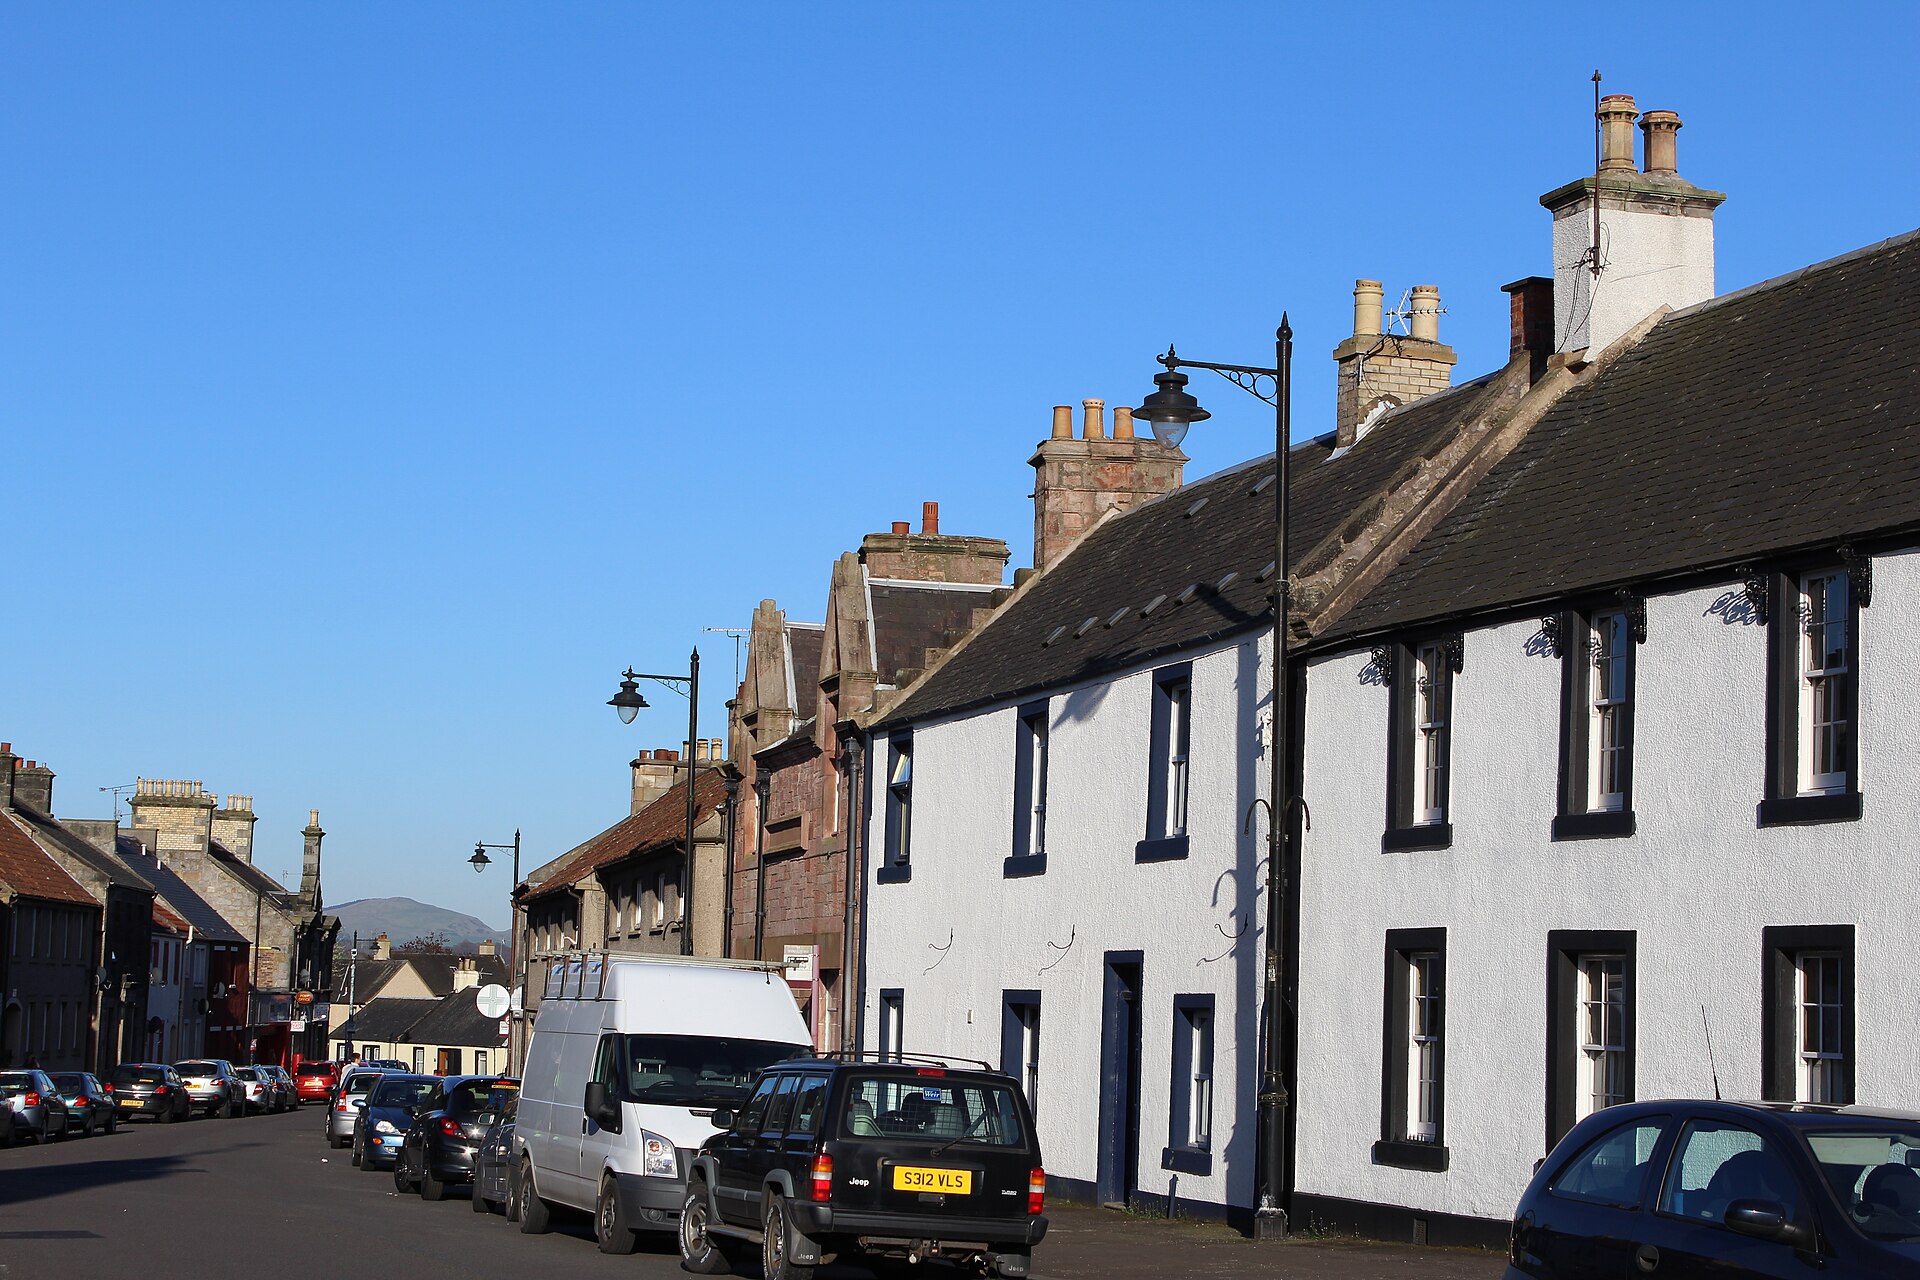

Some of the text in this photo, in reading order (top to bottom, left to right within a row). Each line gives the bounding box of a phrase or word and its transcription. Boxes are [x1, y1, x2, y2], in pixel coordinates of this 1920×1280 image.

[925, 1090, 940, 1098] Weir
[849, 1177, 870, 1187] Jeep
[904, 1171, 963, 1188] S312 VLS
[797, 1253, 814, 1261] Jeep
